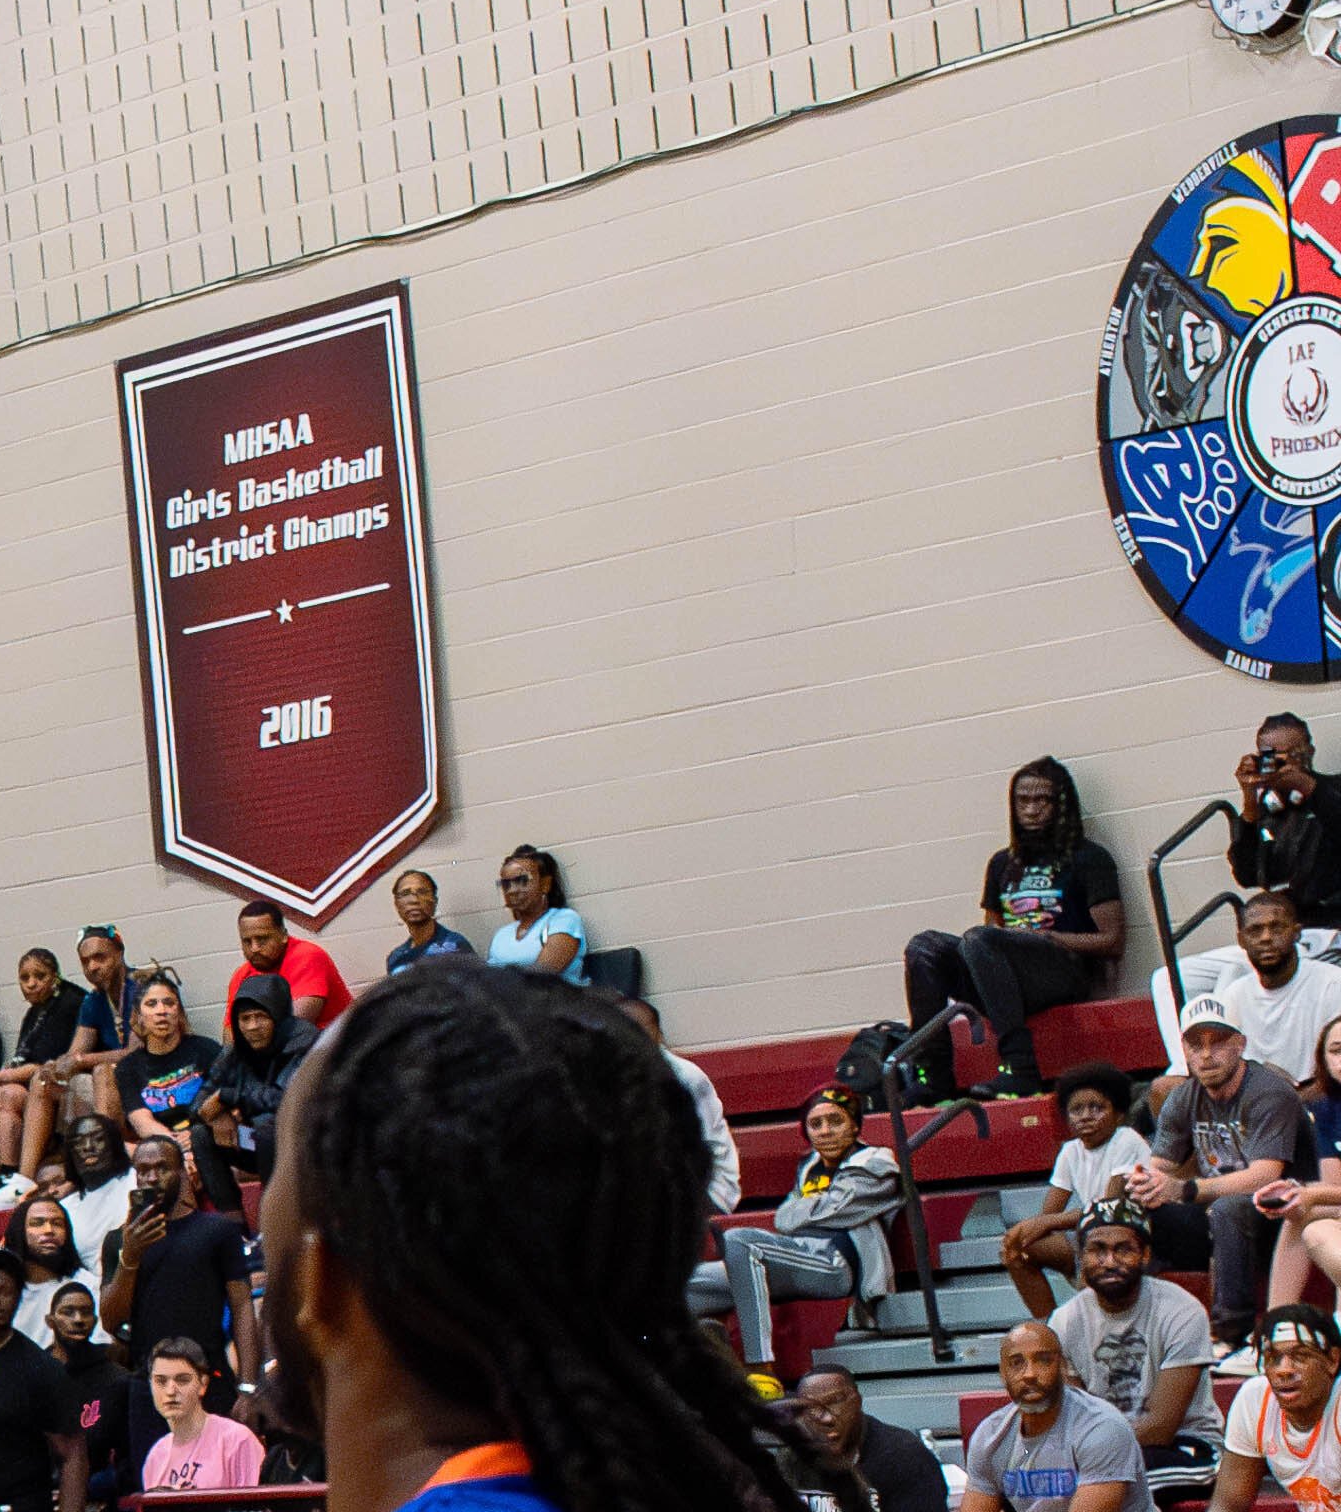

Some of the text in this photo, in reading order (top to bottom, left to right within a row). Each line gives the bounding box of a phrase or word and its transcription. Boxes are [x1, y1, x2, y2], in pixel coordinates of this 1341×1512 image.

[222, 412, 314, 466] MHSAA
[165, 445, 385, 531] Girls Basketball
[169, 503, 390, 579] District Champs
[258, 695, 334, 750] 2016
